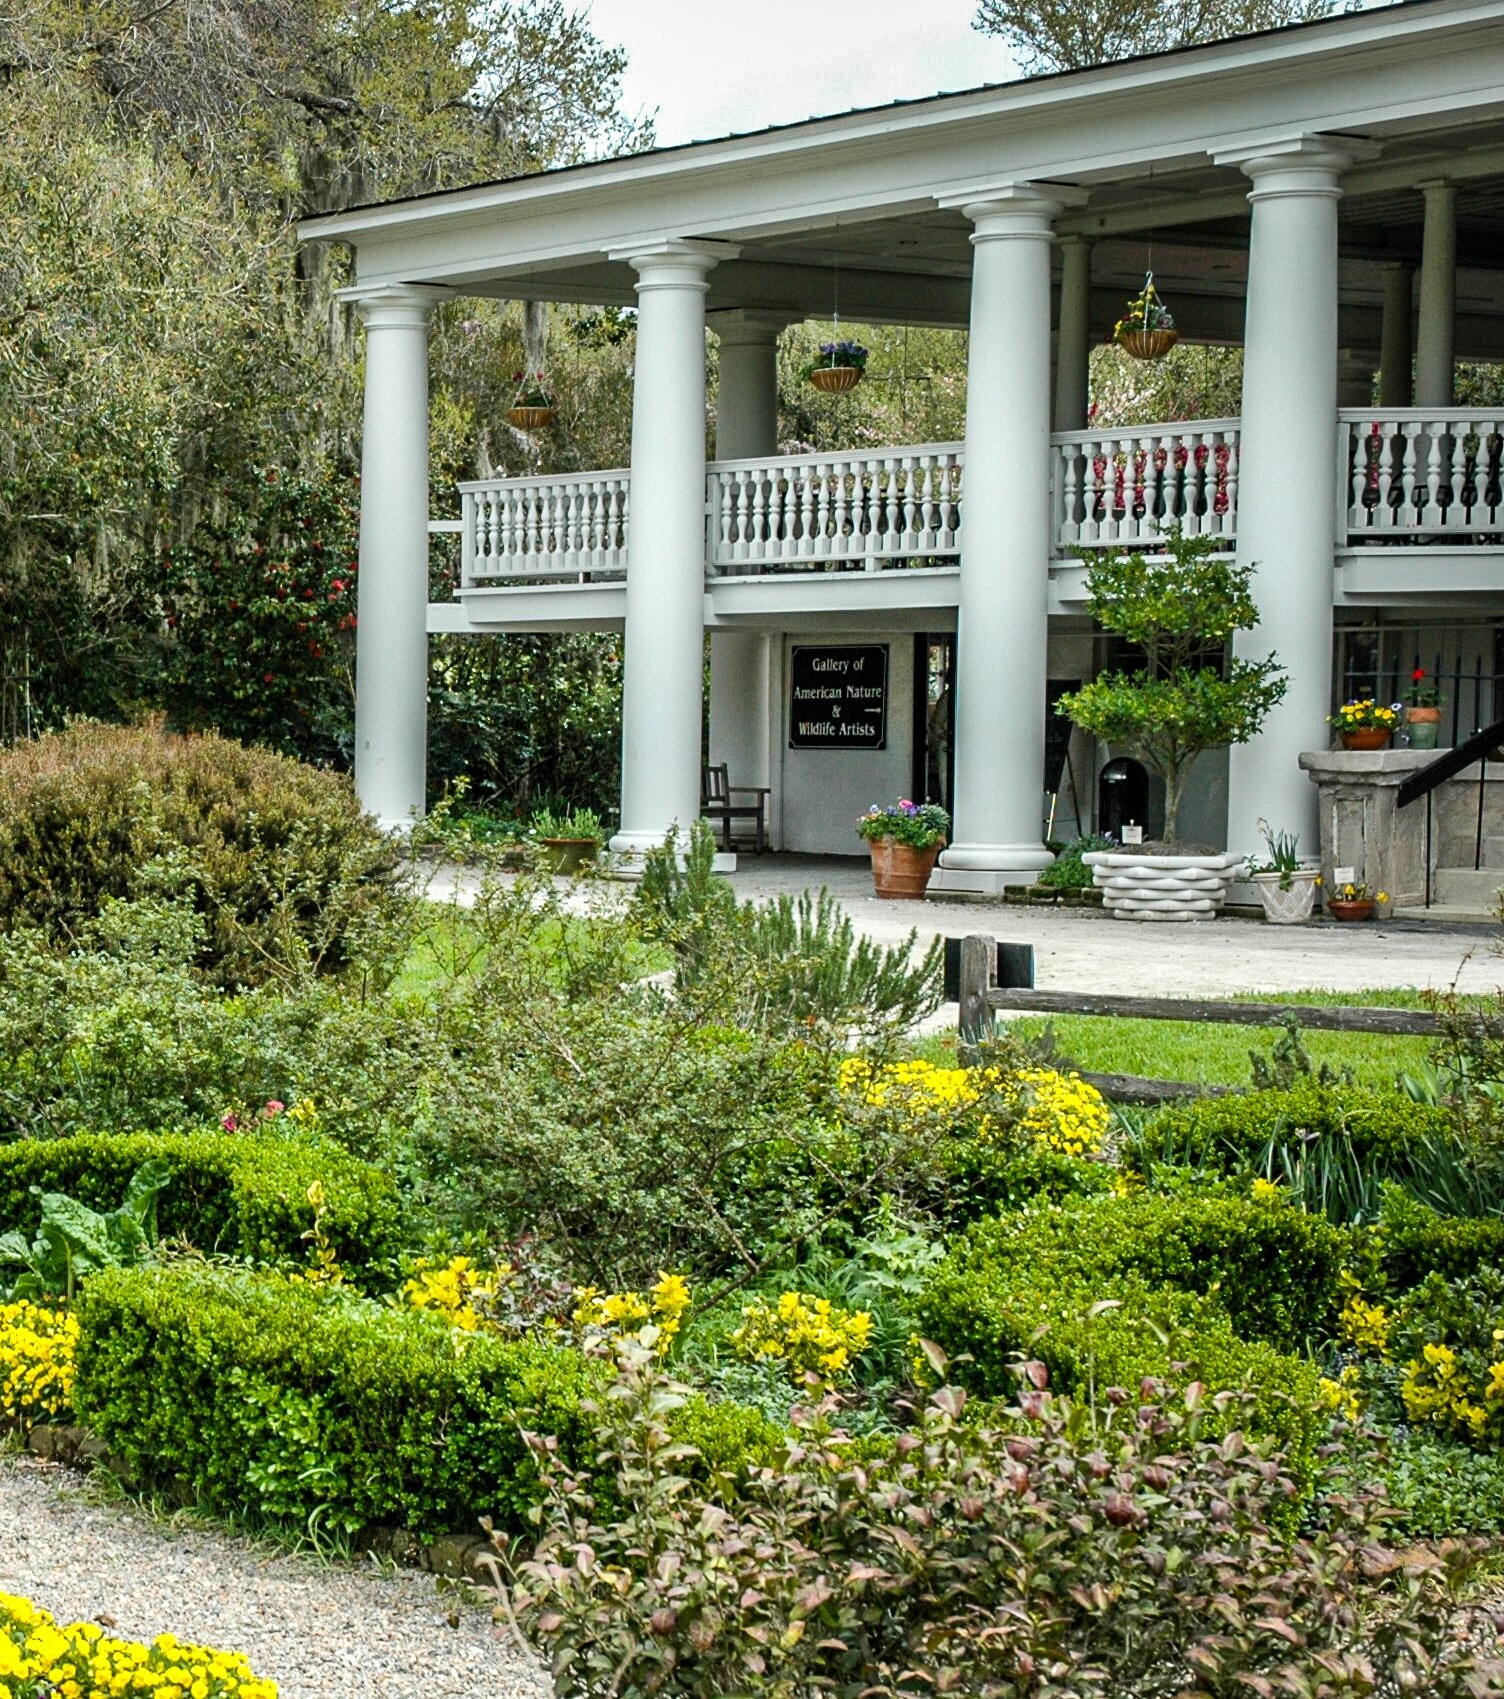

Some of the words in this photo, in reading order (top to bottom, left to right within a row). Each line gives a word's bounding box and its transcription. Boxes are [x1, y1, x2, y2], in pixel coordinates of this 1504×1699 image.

[812, 658, 849, 674] Gallery
[853, 657, 865, 671] of
[794, 685, 842, 699] American
[846, 685, 882, 698] Nature
[832, 705, 841, 718] &
[799, 722, 836, 736] Wildlife
[839, 722, 875, 736] Artists
